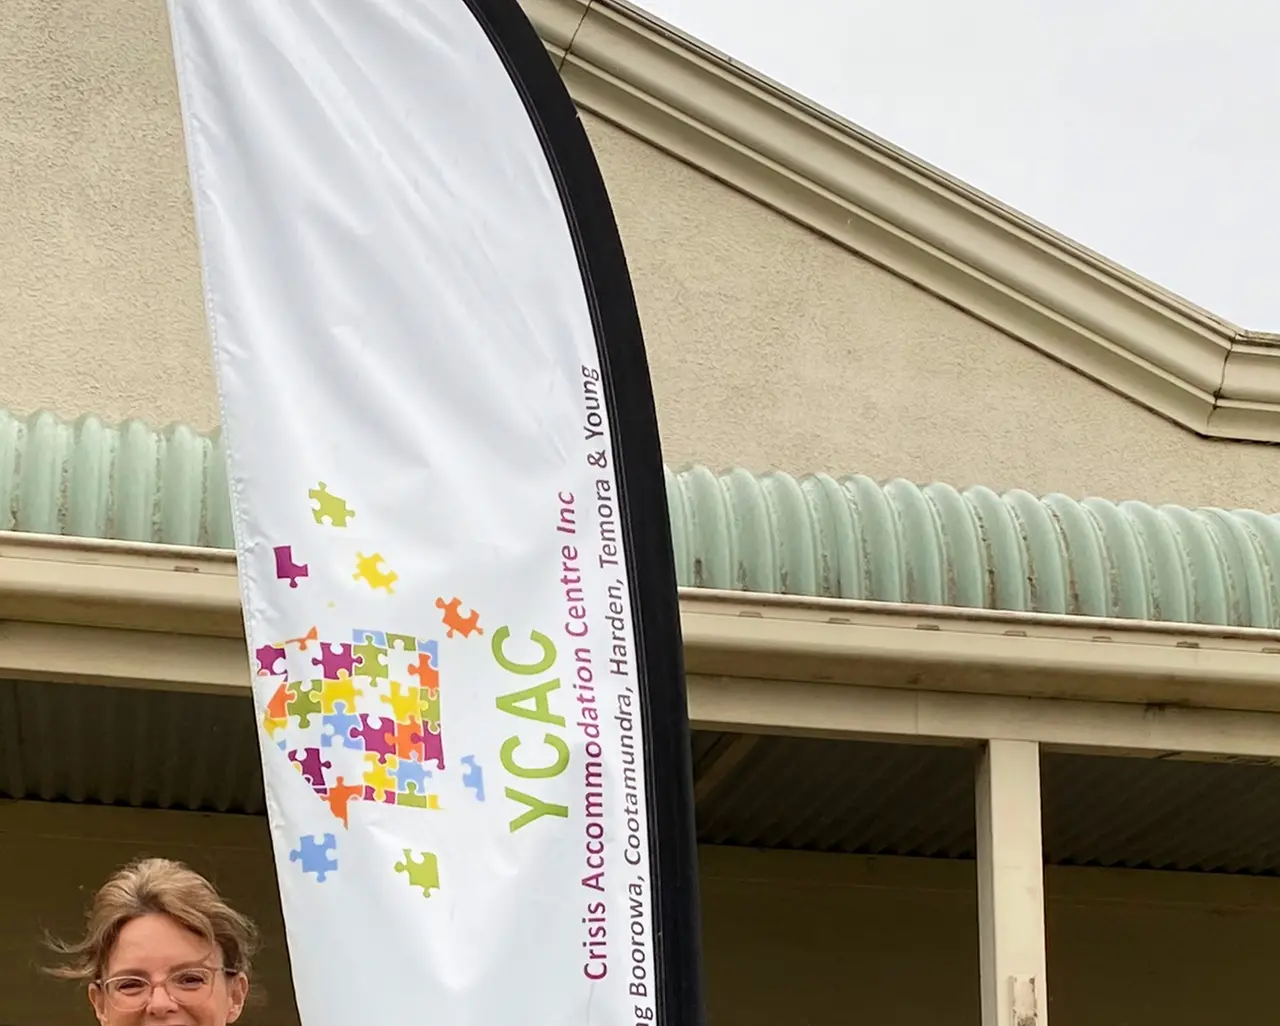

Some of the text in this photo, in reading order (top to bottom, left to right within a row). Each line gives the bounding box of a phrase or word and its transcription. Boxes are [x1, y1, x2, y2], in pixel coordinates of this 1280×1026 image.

[582, 365, 600, 440] Young
[587, 449, 608, 469] &
[595, 479, 619, 569] Temora
[605, 578, 631, 676] Harden,
[491, 625, 570, 833] YCAC
[557, 491, 608, 981] Crisis Accommodation Centre Inc
[611, 685, 642, 866] Cootamundra,
[629, 874, 647, 998] Boorowa,
